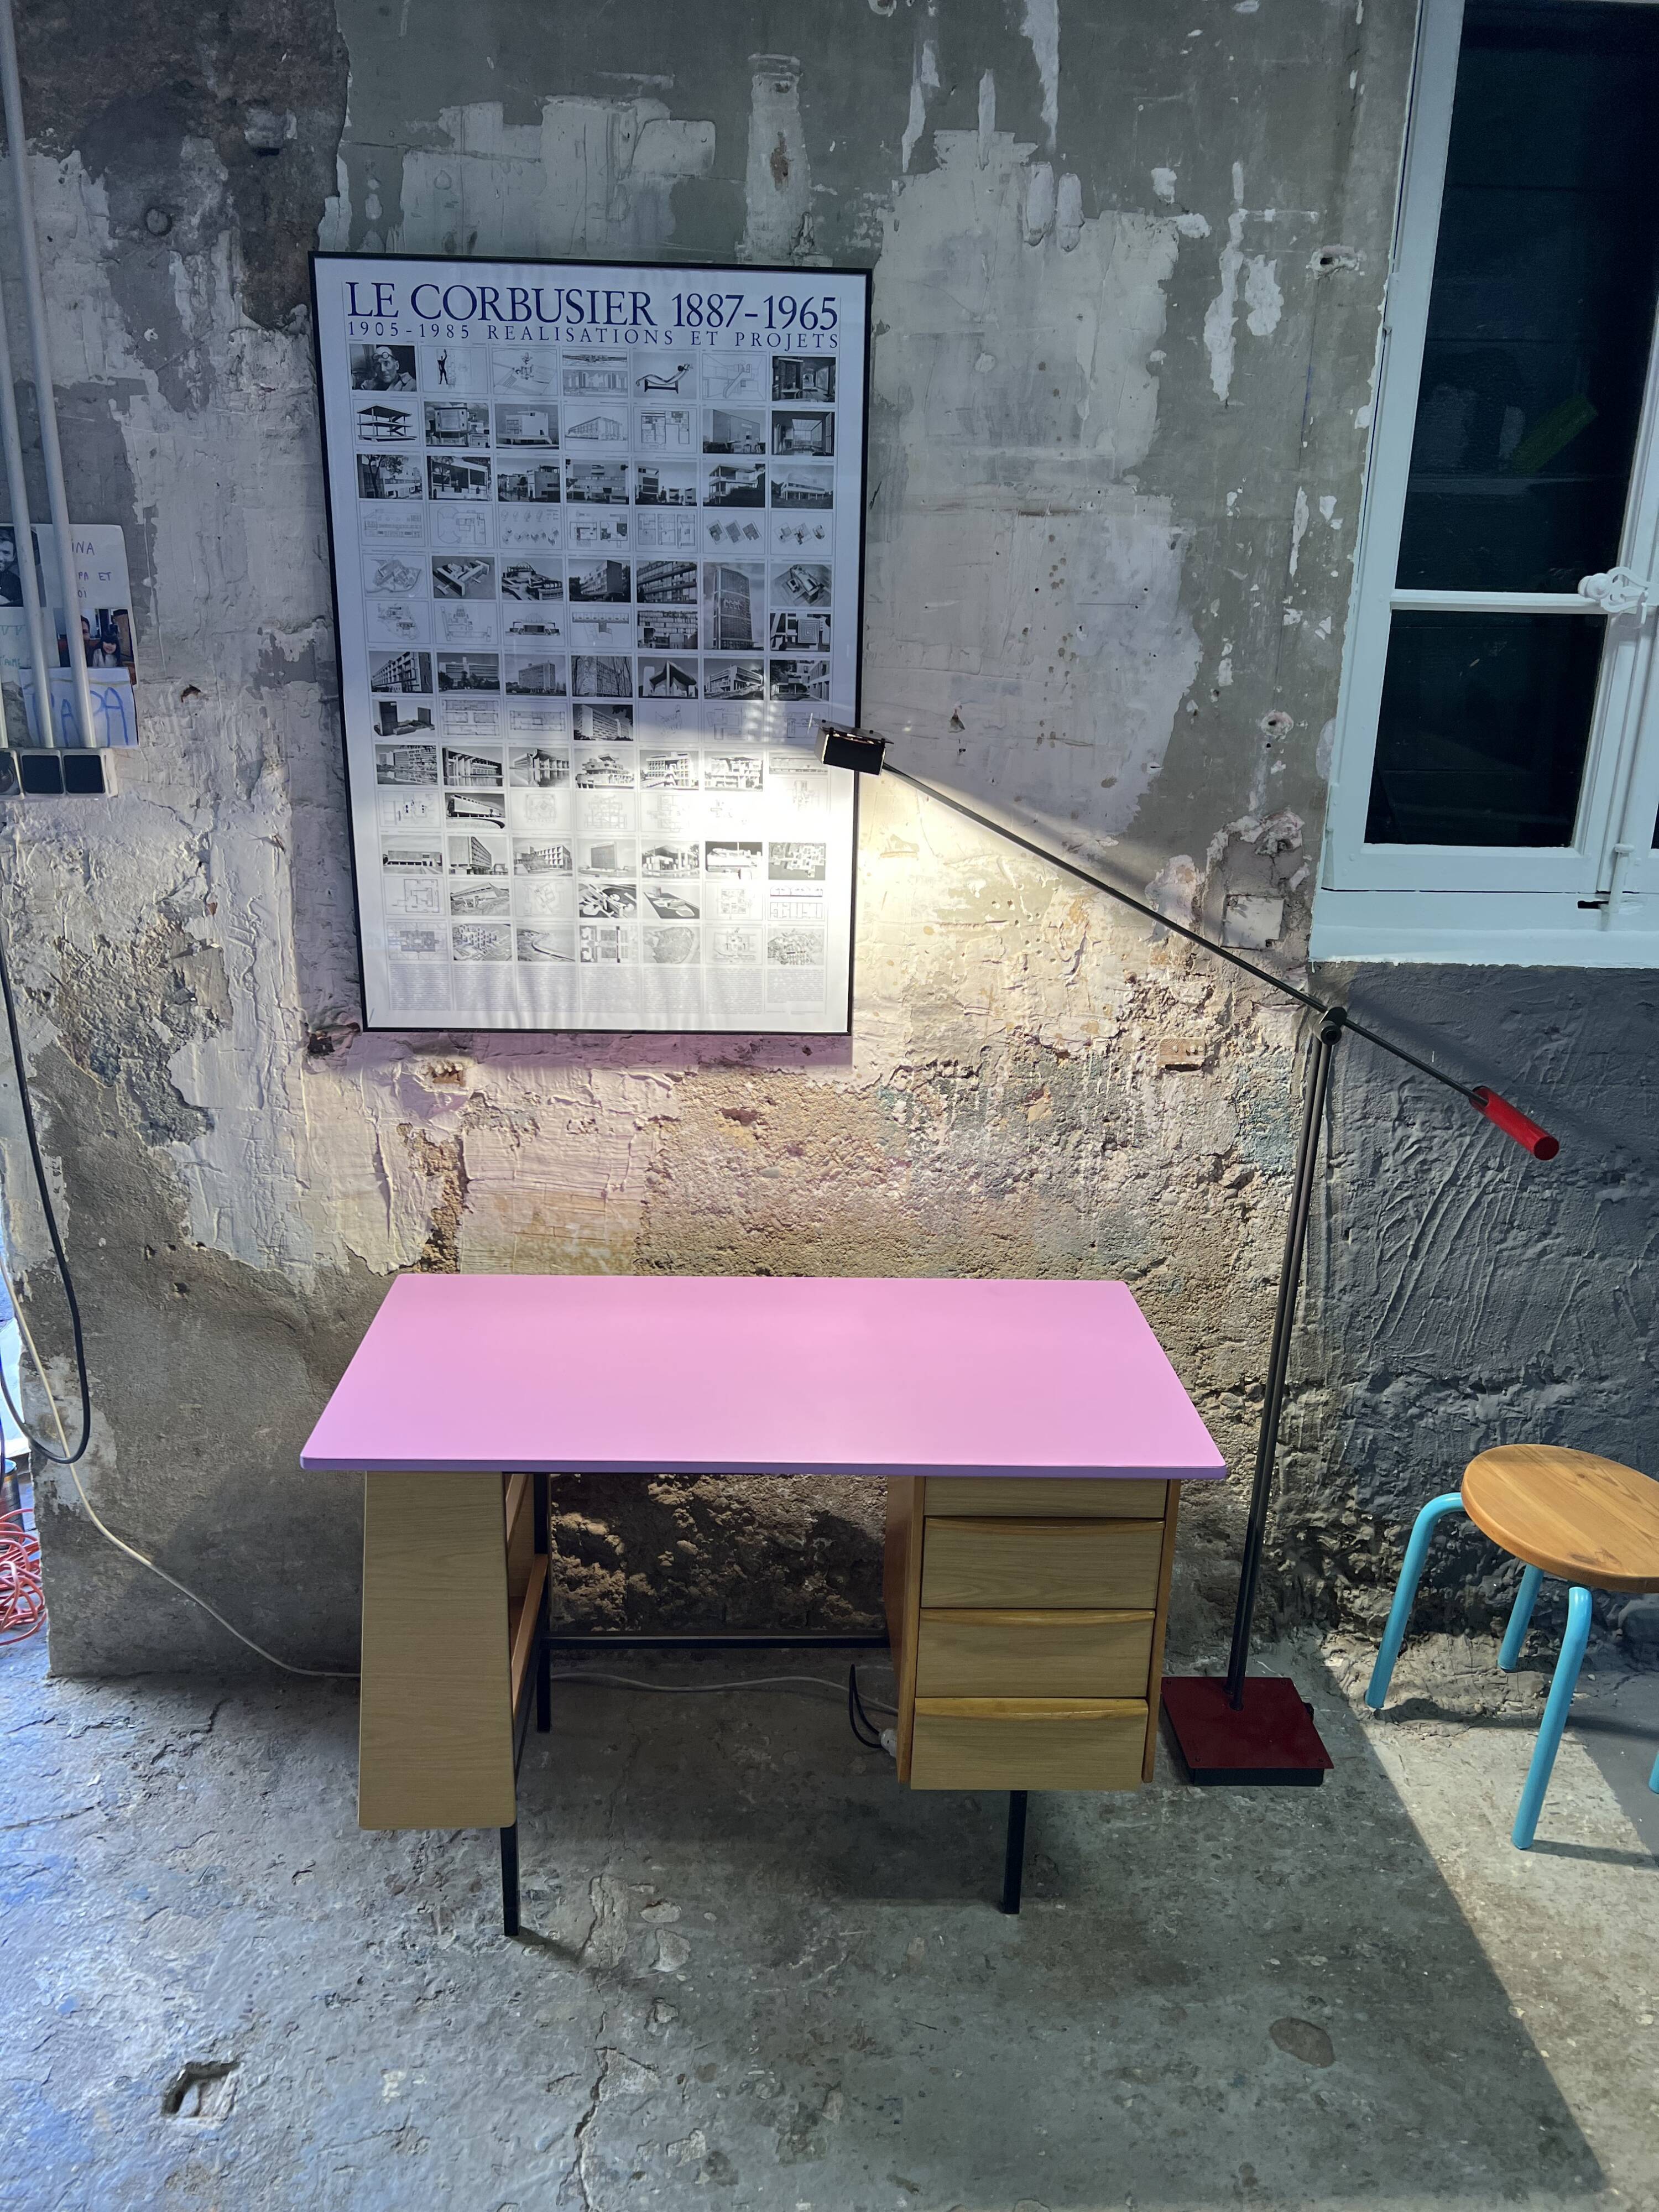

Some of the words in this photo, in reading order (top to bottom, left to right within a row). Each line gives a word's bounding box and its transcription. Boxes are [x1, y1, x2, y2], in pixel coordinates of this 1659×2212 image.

[345, 281, 399, 318] LE
[410, 283, 658, 327] CORBUSIER
[671, 293, 838, 331] 1887-1965
[487, 325, 673, 346] REALISATIONS
[690, 330, 718, 346] ET
[734, 332, 838, 352] PROJETS
[98, 571, 111, 581] ET
